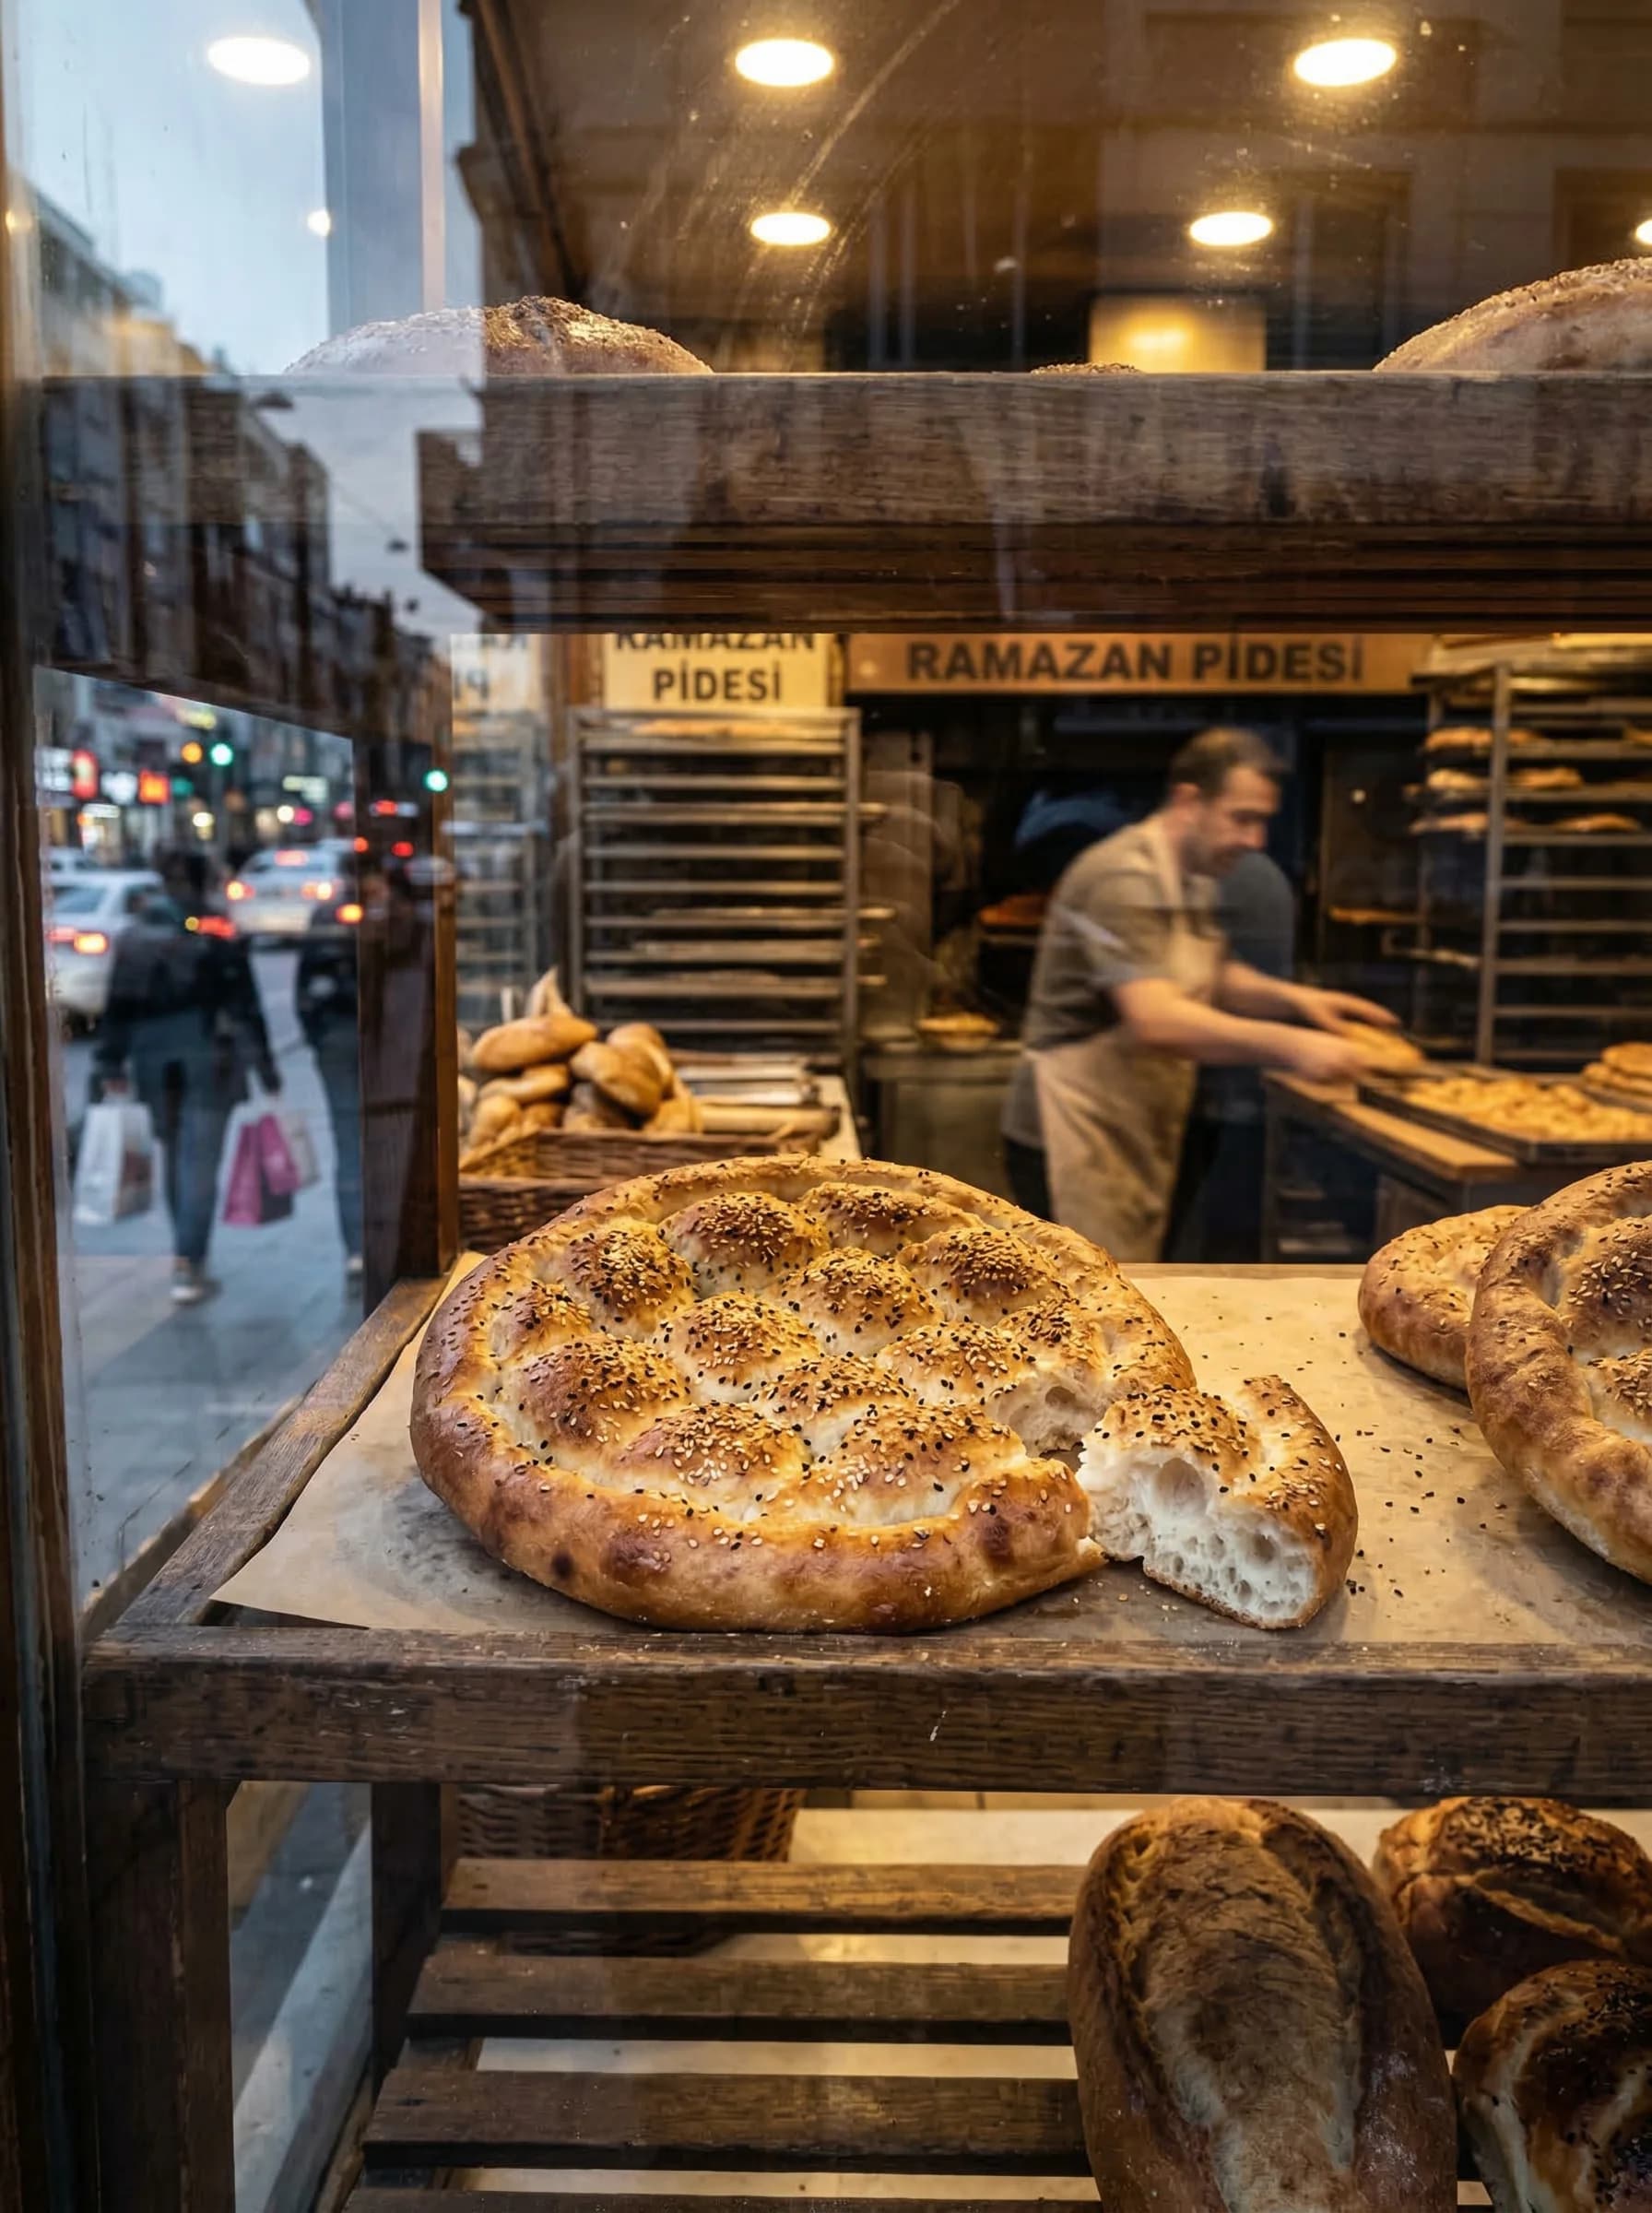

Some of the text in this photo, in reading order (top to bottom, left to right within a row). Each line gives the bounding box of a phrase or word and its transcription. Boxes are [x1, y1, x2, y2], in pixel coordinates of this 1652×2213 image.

[907, 633, 1363, 681] RAMAZAN PİDESİ
[653, 659, 781, 701] PİDESİ
